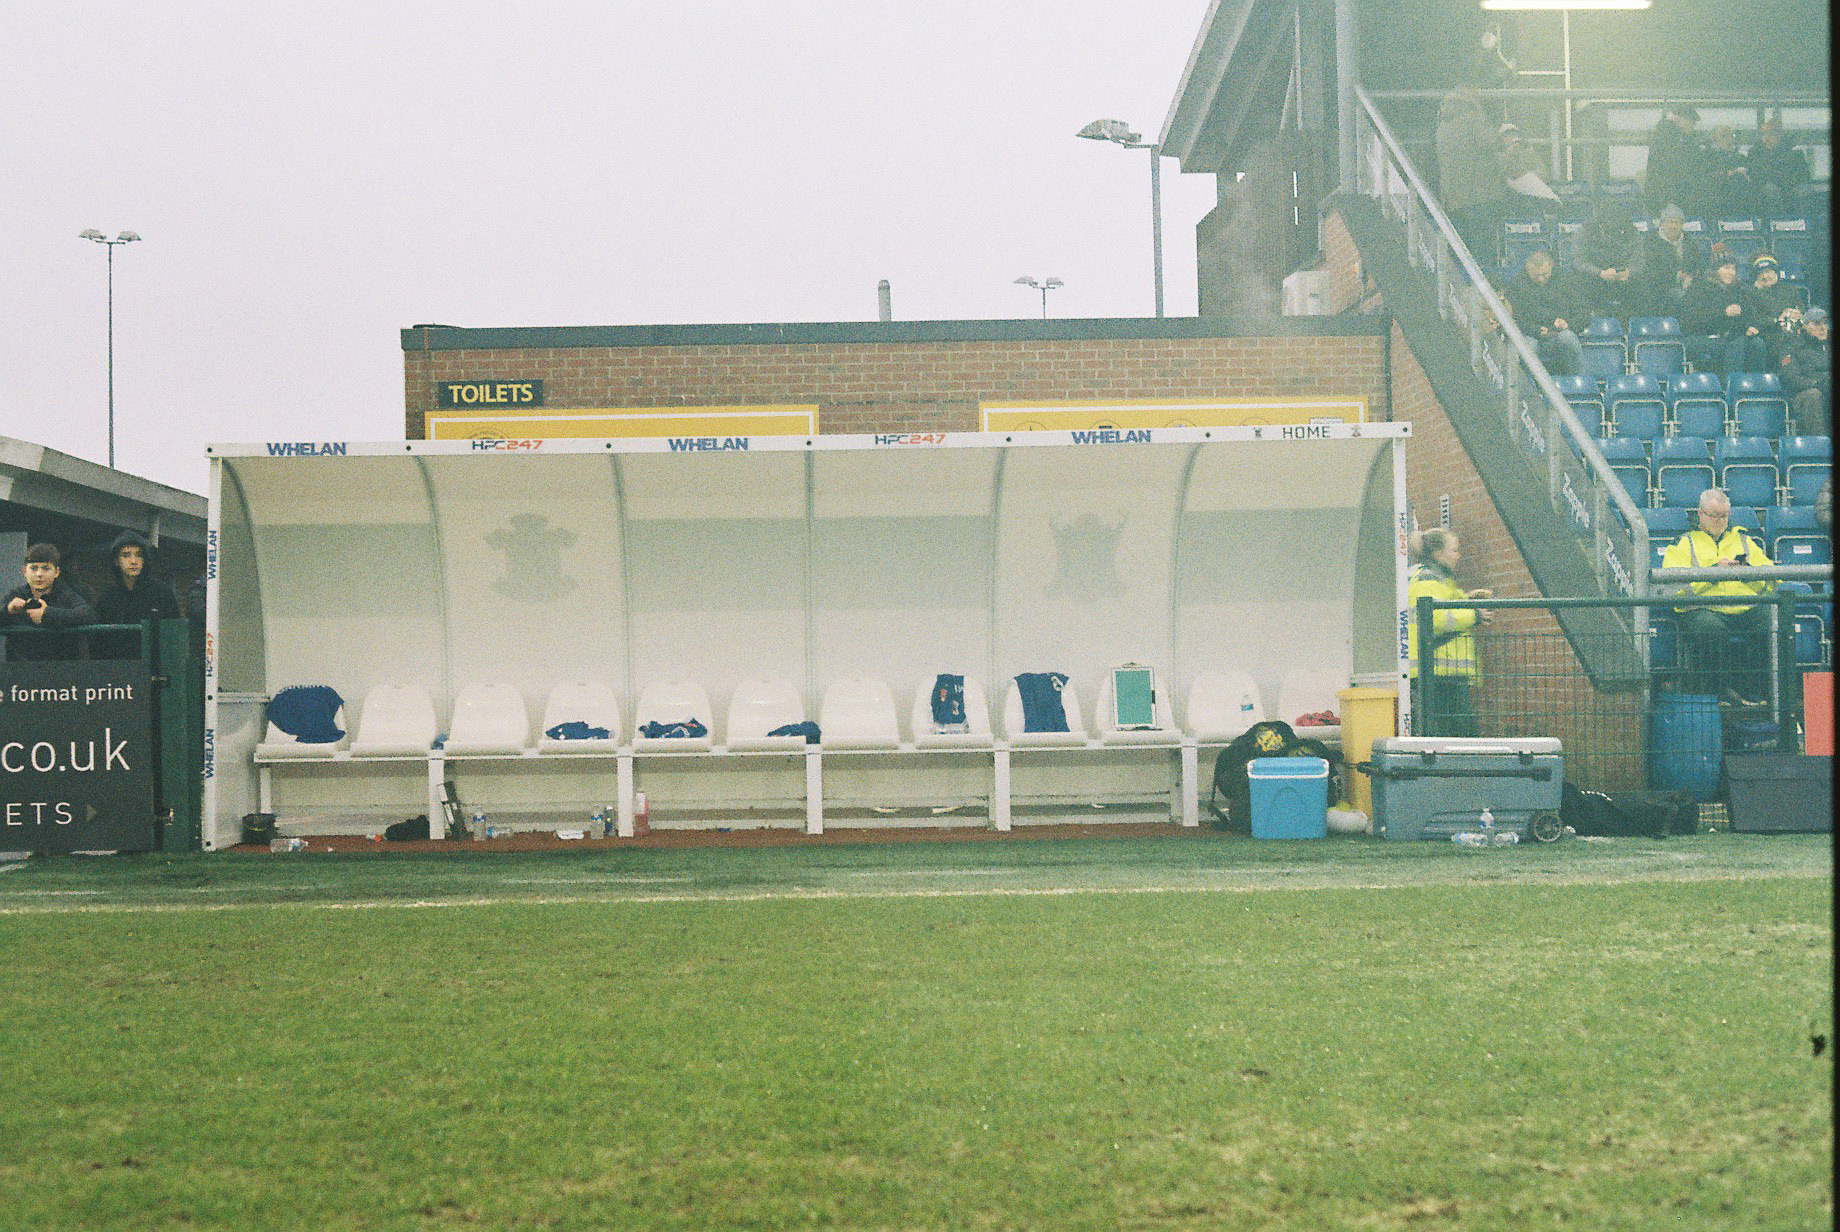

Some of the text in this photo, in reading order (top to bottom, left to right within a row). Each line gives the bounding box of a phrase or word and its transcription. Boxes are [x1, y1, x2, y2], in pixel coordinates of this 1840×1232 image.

[448, 383, 533, 404] TOILETS
[1071, 429, 1151, 445] WHELAN
[1282, 426, 1331, 439] HOME
[266, 441, 347, 456] WHELAN
[667, 437, 748, 452] WHELAN
[207, 530, 217, 580] WHELAN
[1399, 609, 1409, 659] WHELAN
[10, 684, 78, 702] format
[85, 683, 133, 705] print
[205, 728, 214, 779] WHELAN
[6, 801, 73, 826] ETS
